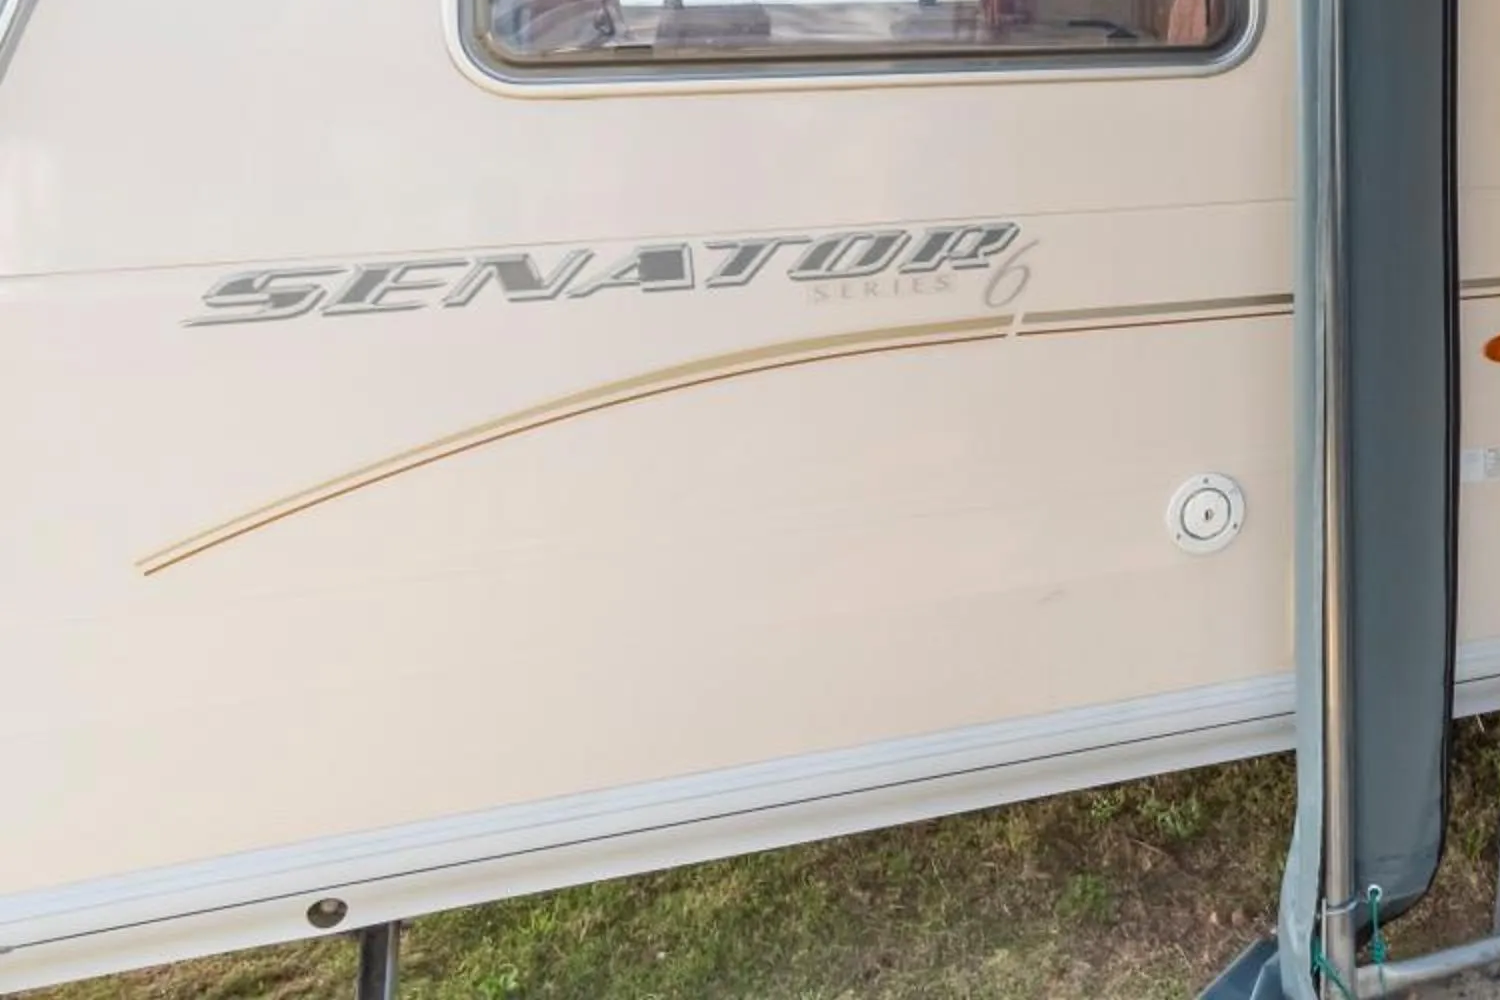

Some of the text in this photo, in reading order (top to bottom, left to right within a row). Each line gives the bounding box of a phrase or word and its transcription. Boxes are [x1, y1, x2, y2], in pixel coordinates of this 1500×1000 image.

[182, 221, 1021, 327] SENATOR
[812, 239, 1041, 309] SERIES 6
